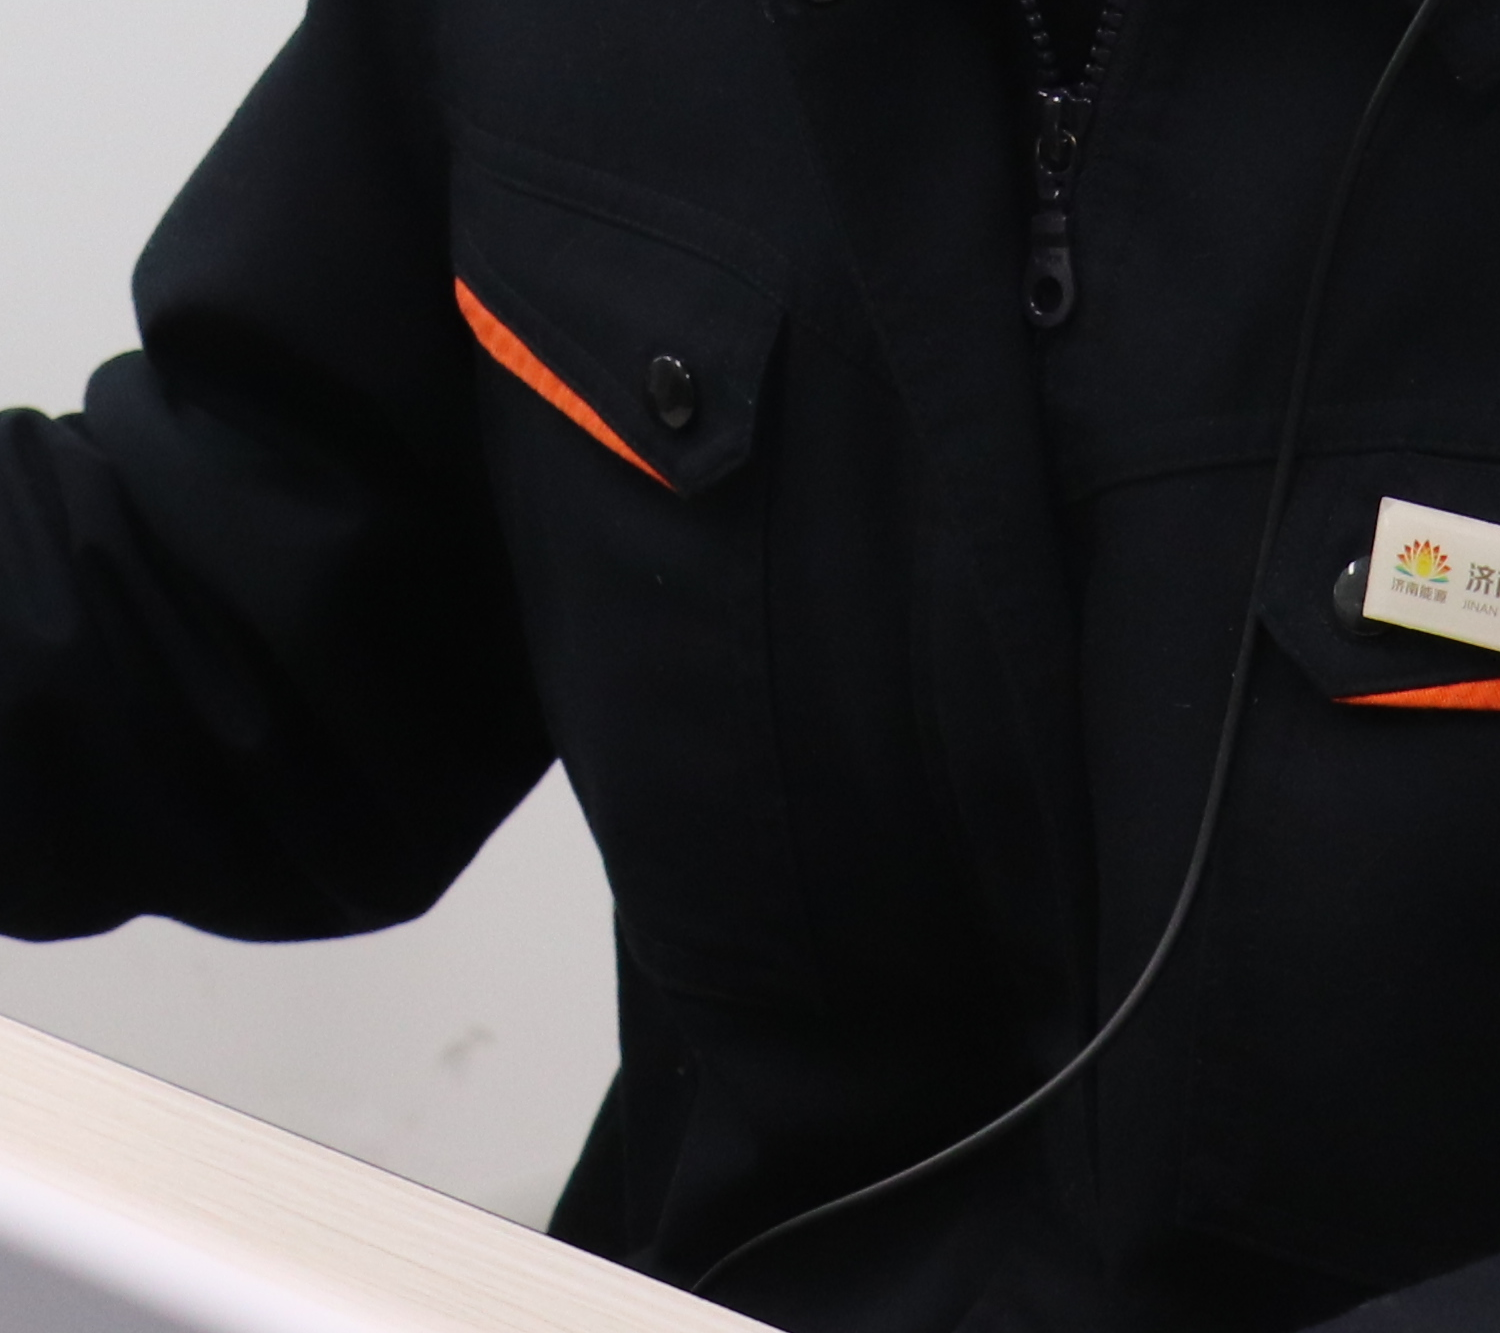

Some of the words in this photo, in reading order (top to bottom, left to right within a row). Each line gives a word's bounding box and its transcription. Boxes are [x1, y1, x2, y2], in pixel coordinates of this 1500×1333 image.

[1390, 576, 1449, 605] 济南能源
[1462, 599, 1499, 618] JINAN
